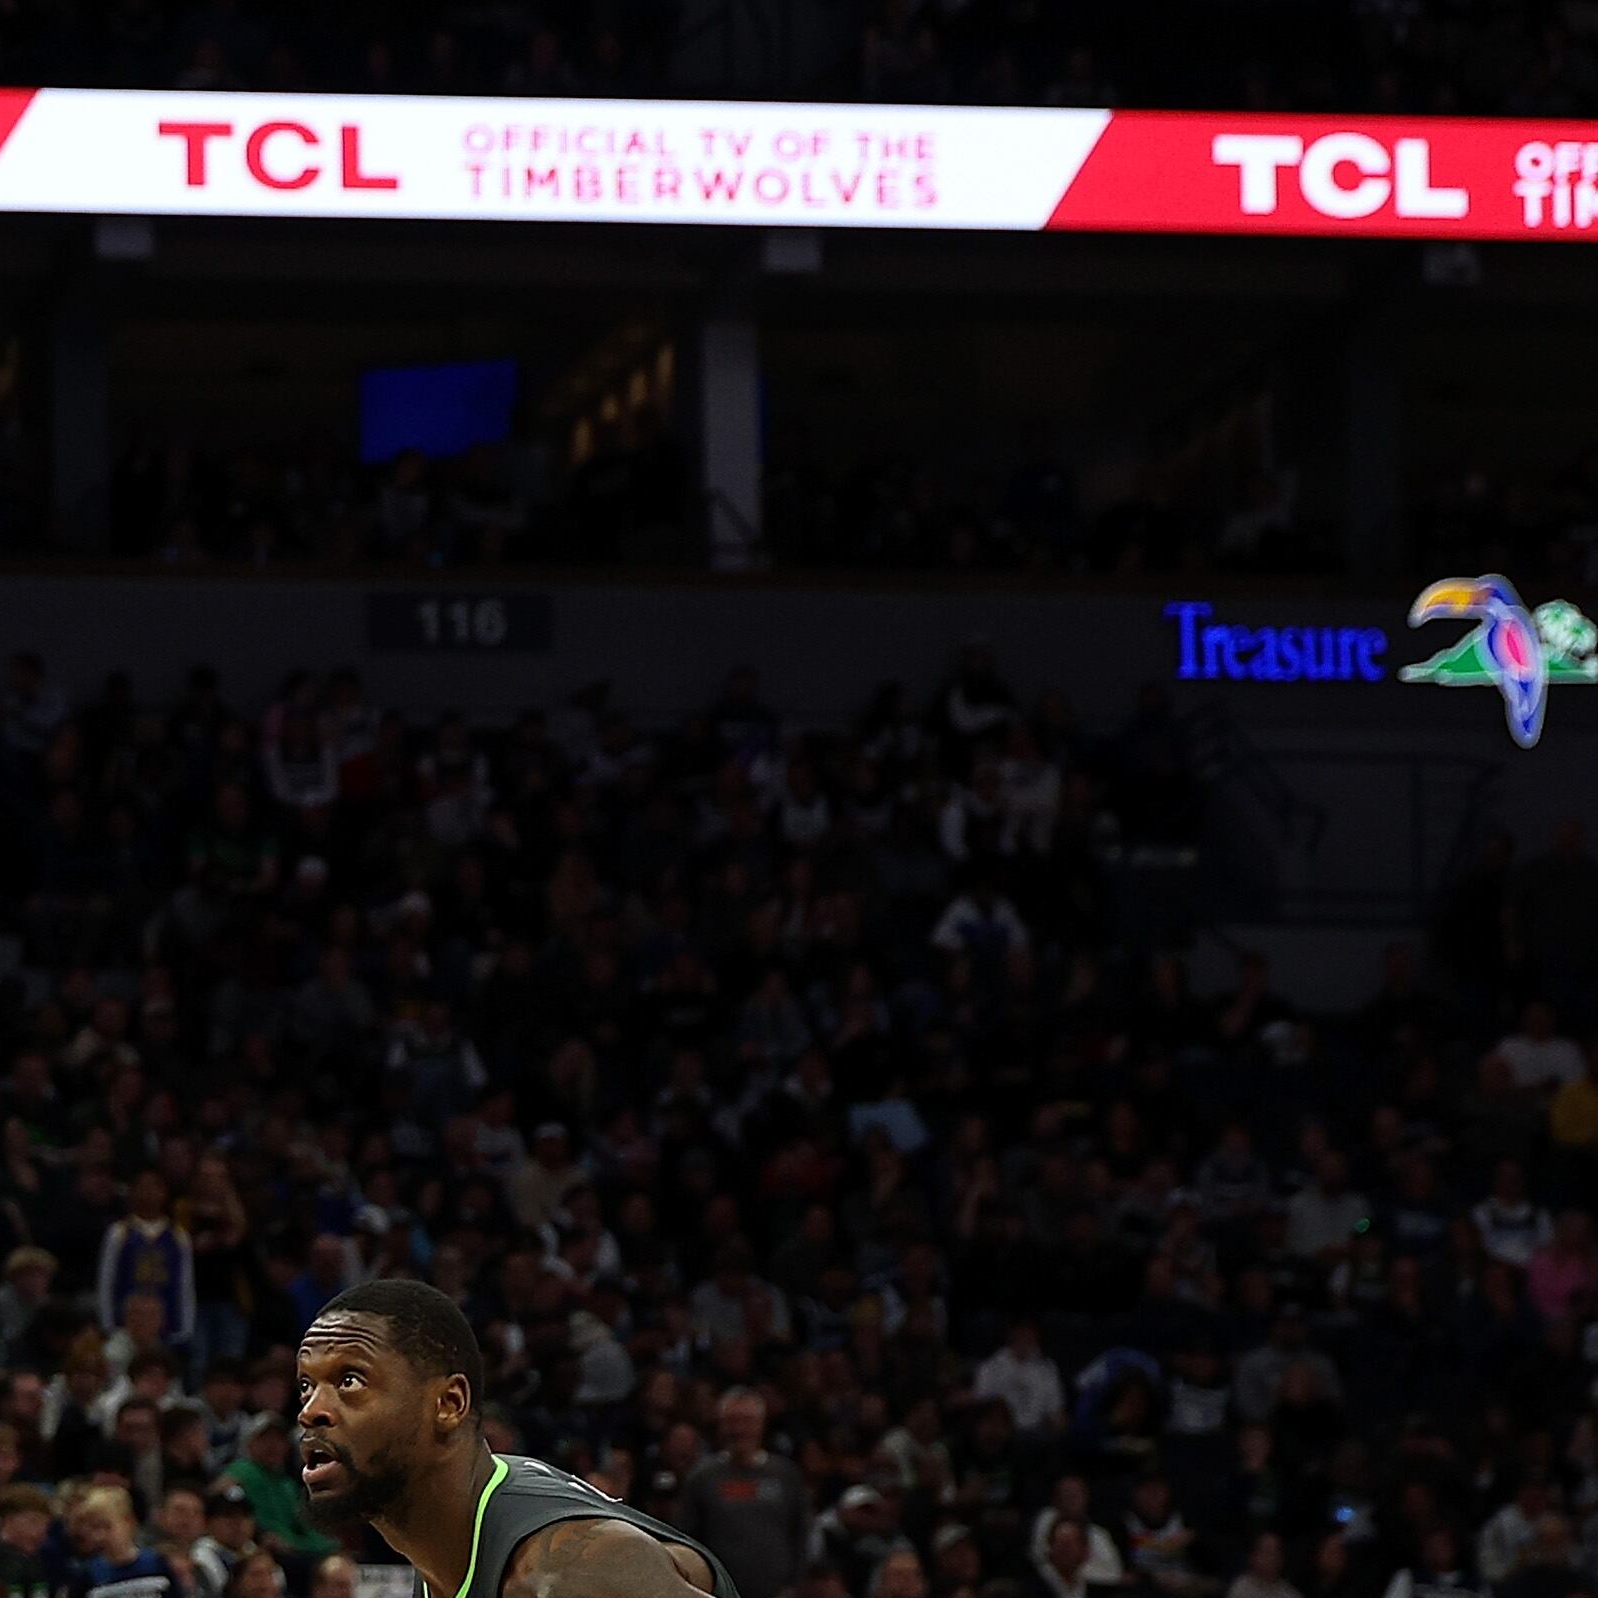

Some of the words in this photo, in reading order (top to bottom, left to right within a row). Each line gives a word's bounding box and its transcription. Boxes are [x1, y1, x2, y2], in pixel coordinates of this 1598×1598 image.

[158, 121, 399, 190] TCL
[463, 123, 671, 157] OFFICIAL
[700, 128, 754, 158] TV
[771, 130, 827, 160] OF
[856, 131, 937, 161] THE
[1211, 132, 1470, 220] TCL
[466, 161, 939, 207] TIMBERWOLVES
[1162, 600, 1389, 682] Treasure
